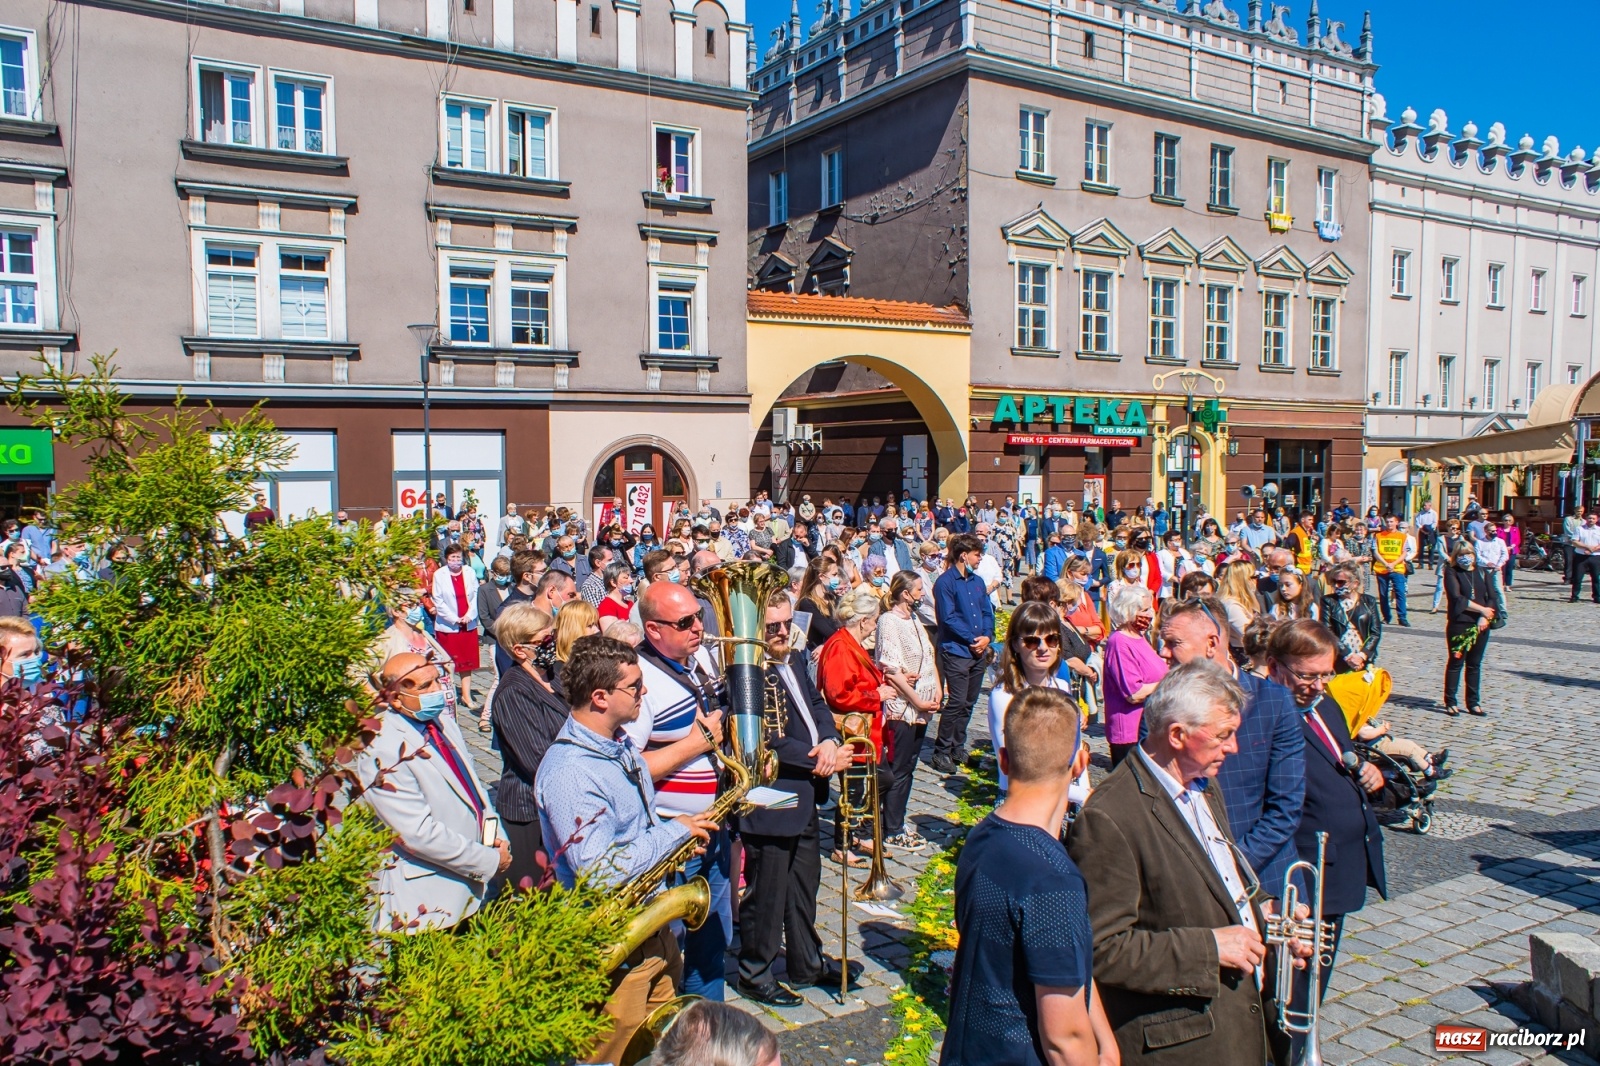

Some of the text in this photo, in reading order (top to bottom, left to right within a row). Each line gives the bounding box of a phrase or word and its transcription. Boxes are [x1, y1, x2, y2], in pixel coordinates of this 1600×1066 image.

[992, 394, 1147, 427] APTEKA
[1080, 437, 1135, 446] FARMACEUTYCZNE
[637, 485, 650, 505] 432
[632, 507, 646, 526] 716
